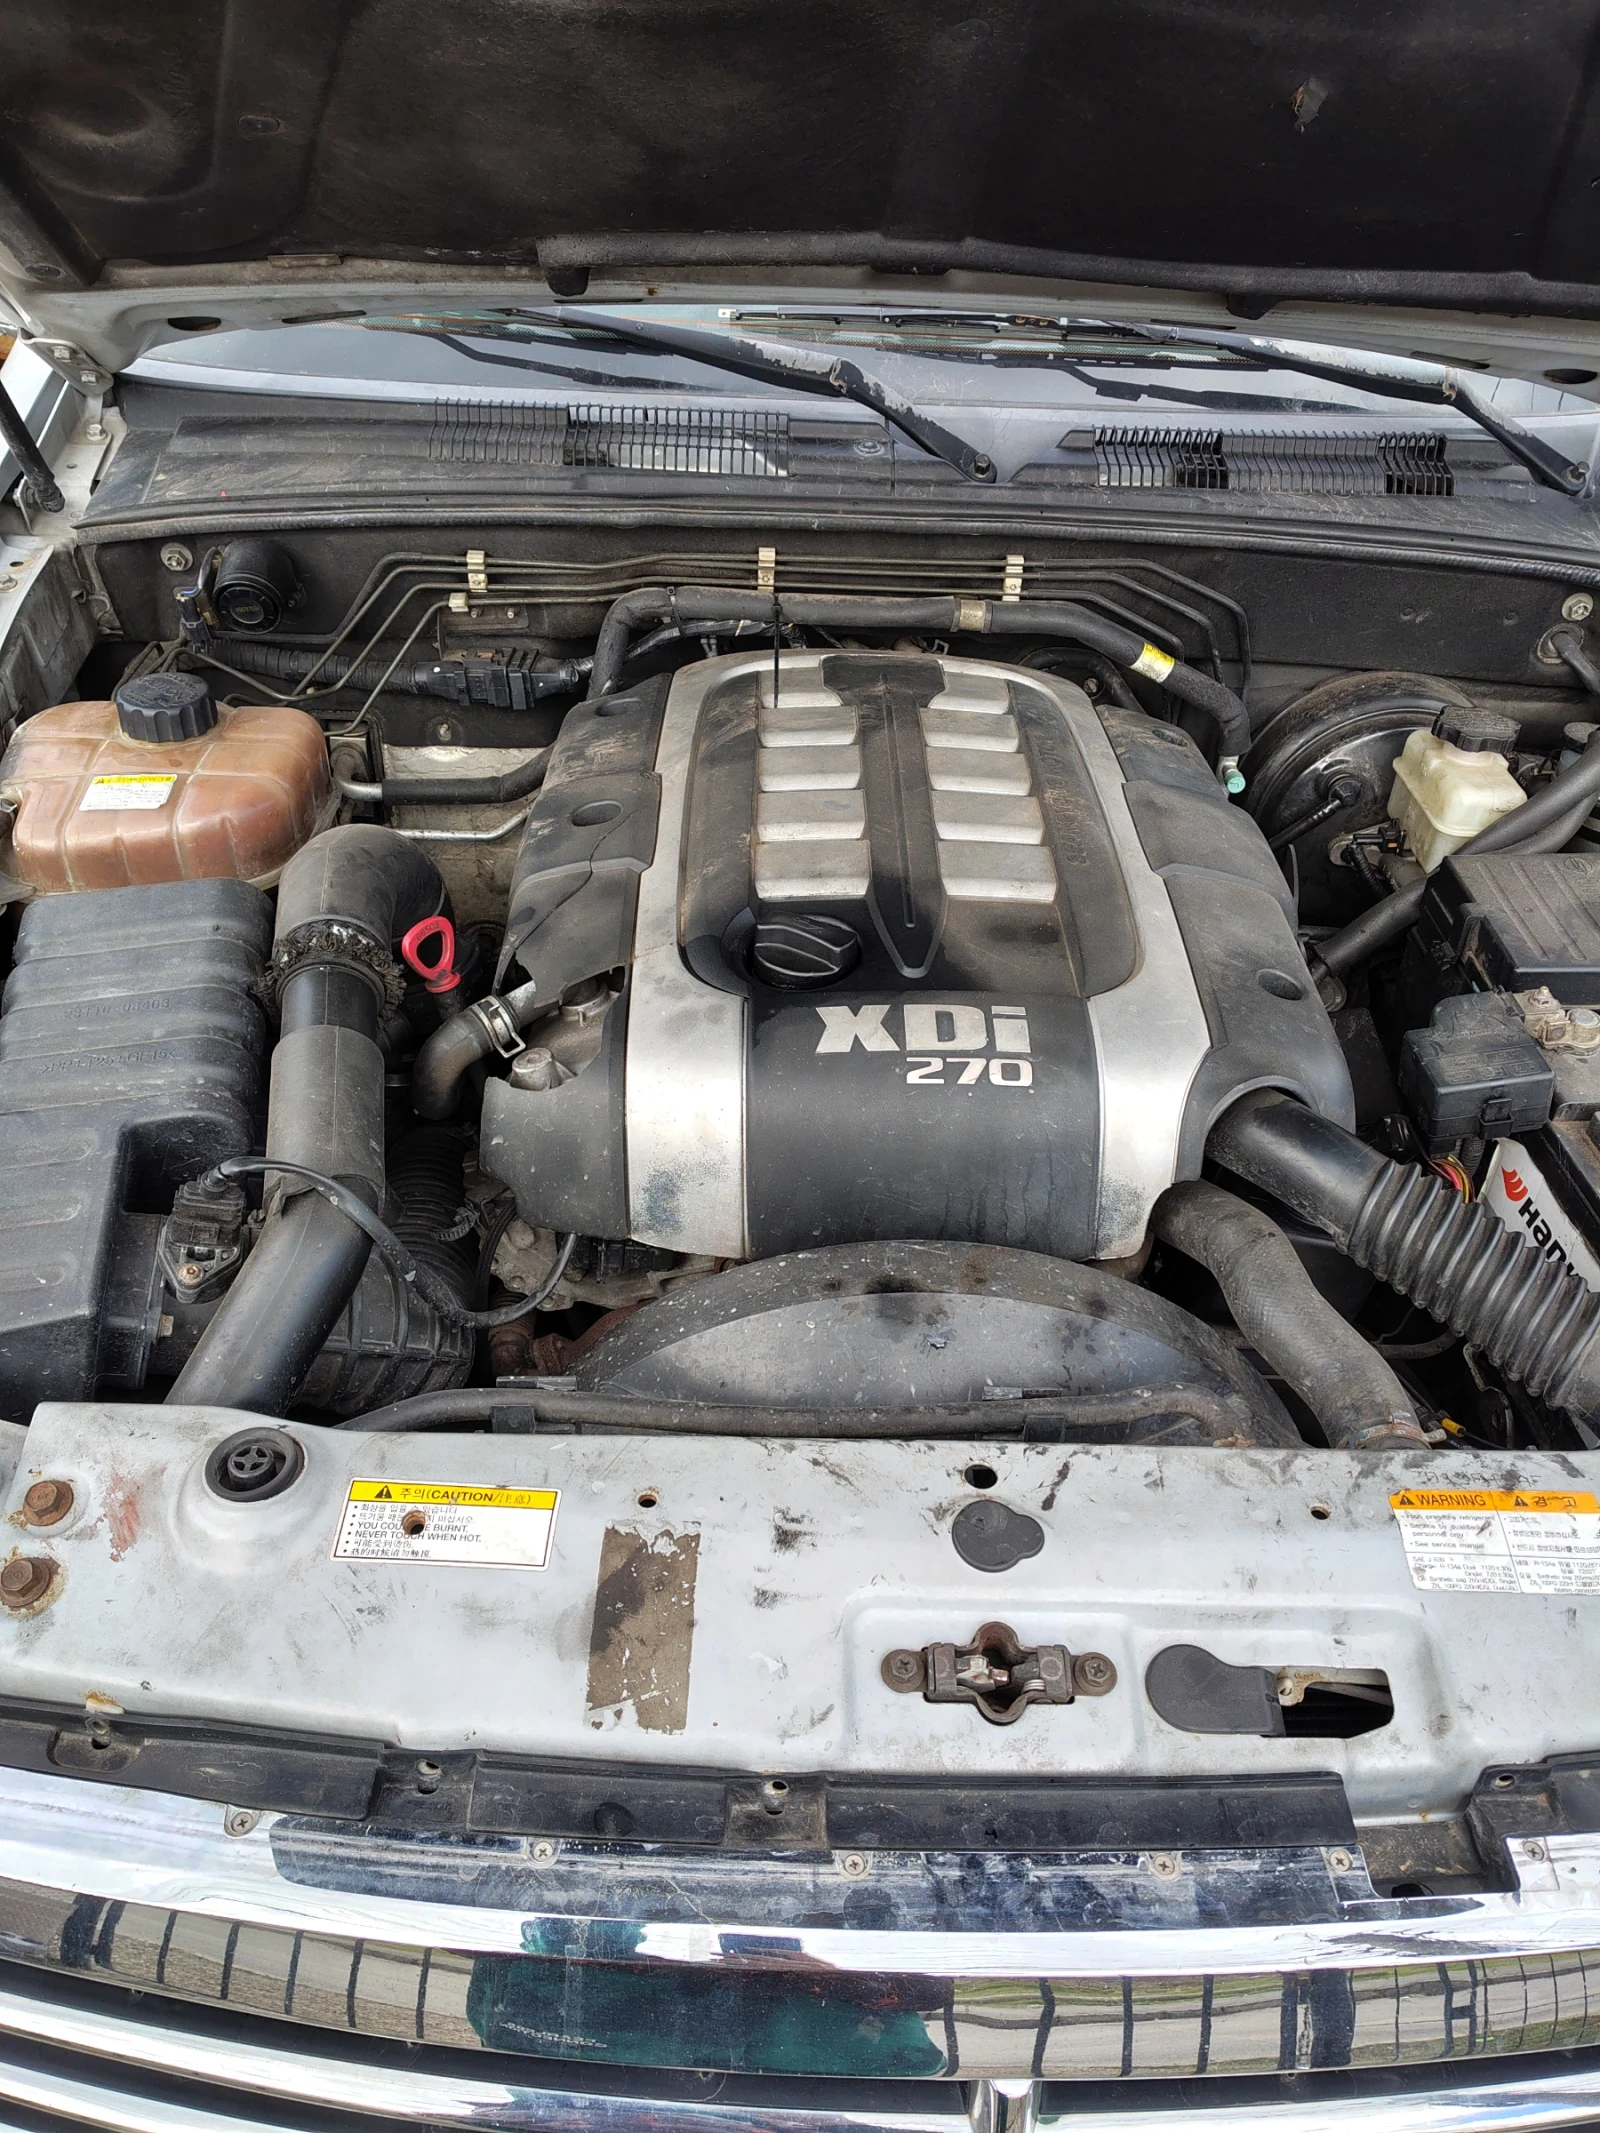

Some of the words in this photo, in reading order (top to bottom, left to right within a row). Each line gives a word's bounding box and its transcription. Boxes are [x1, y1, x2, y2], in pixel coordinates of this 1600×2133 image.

[815, 1004, 1031, 1053] XDi
[906, 1057, 1033, 1087] 270
[1416, 1494, 1486, 1506] WARNING
[357, 1521, 378, 1530] YOU
[433, 1524, 468, 1533] BURNT.
[354, 1530, 388, 1539] NEVER
[427, 1532, 457, 1541] WHEN
[459, 1533, 482, 1543] HOT.
